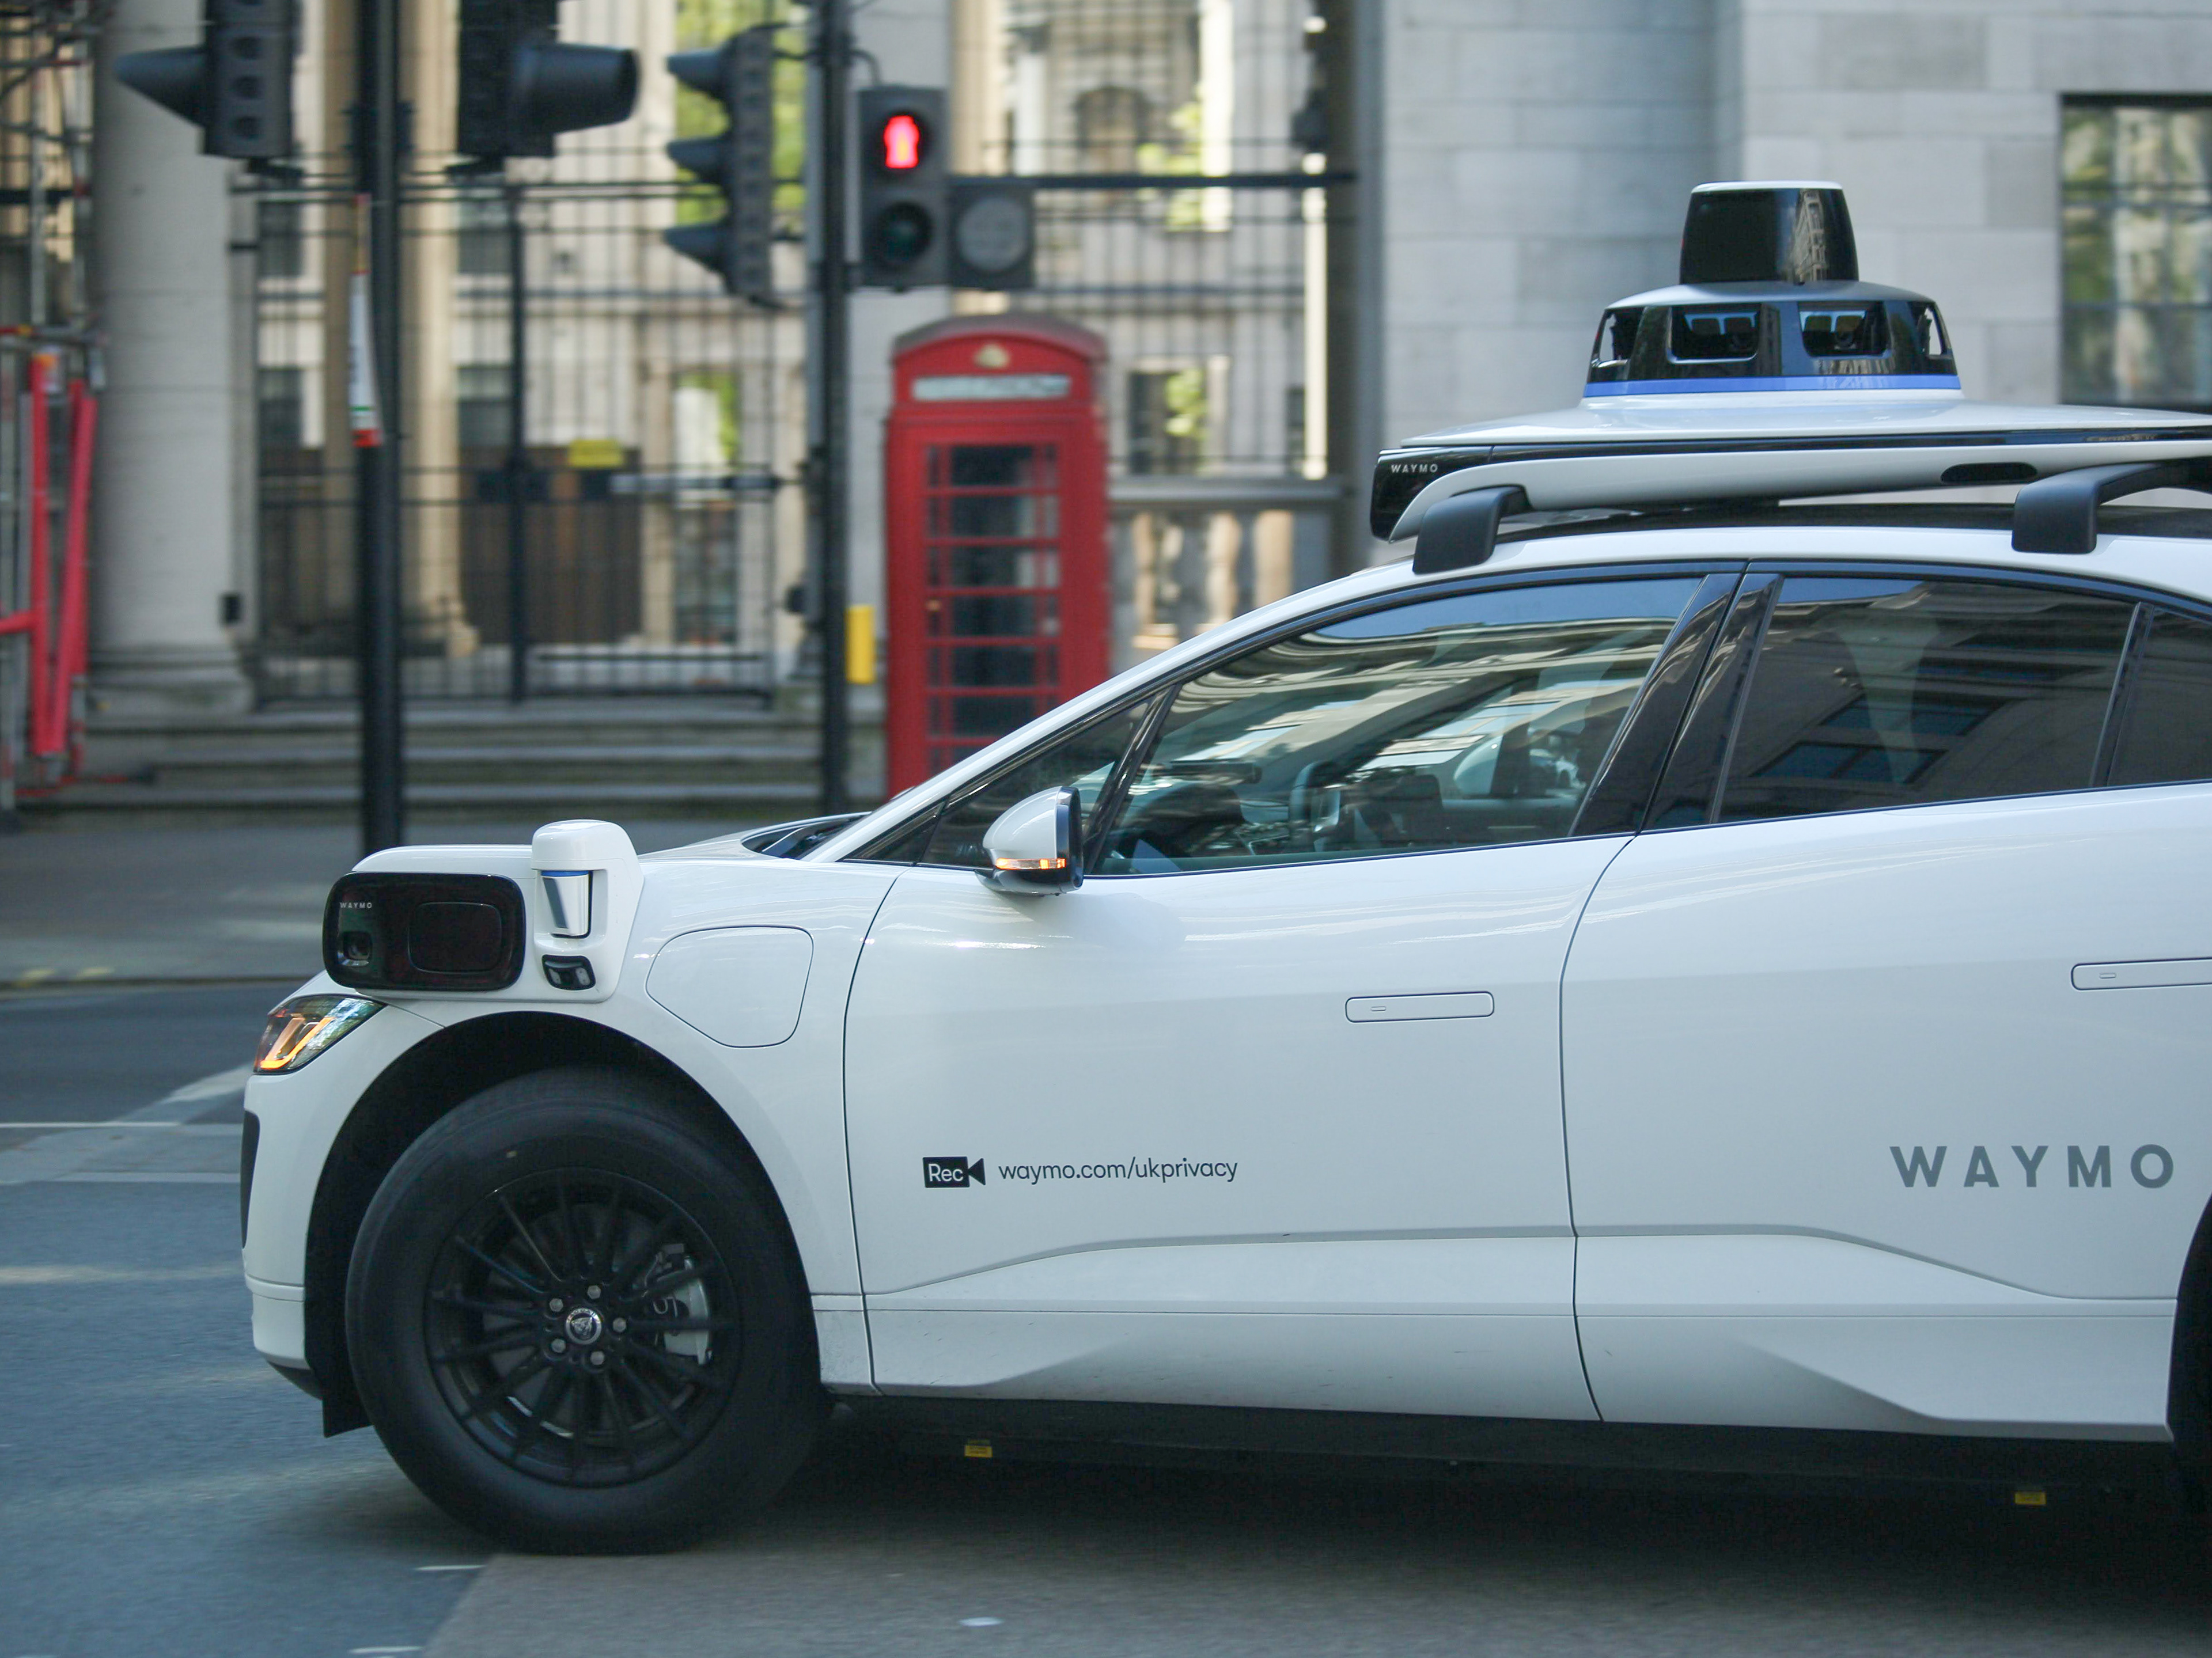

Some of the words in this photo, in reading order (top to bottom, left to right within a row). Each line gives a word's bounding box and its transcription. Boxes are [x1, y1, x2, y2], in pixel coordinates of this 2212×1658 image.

[1391, 464, 1438, 473] WAYMO
[928, 1163, 964, 1182] Rec
[998, 1156, 1238, 1185] waymo.com/ukprivacy
[1889, 1144, 2173, 1189] WAYMO
